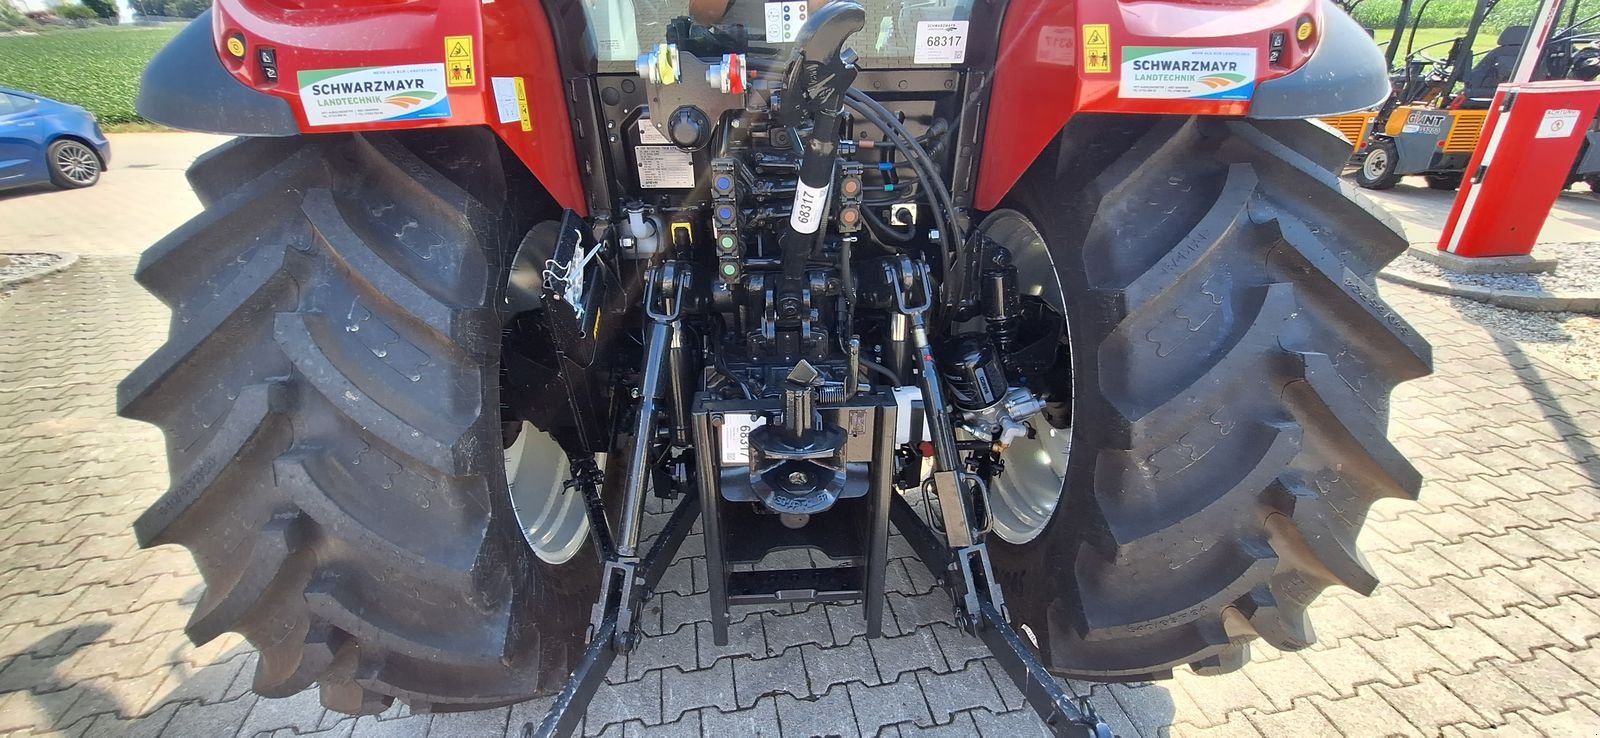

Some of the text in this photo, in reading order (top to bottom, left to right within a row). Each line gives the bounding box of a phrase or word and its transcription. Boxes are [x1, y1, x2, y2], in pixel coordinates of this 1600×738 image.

[927, 36, 961, 46] 68317
[1133, 60, 1237, 71] SCHWARZMAYR
[1135, 74, 1196, 82] LANDTECHNIK
[312, 79, 424, 95] SCHWARZMAYR
[317, 95, 383, 107] LANDTECHNIK
[798, 191, 815, 224] 68317
[740, 425, 750, 457] 68317
